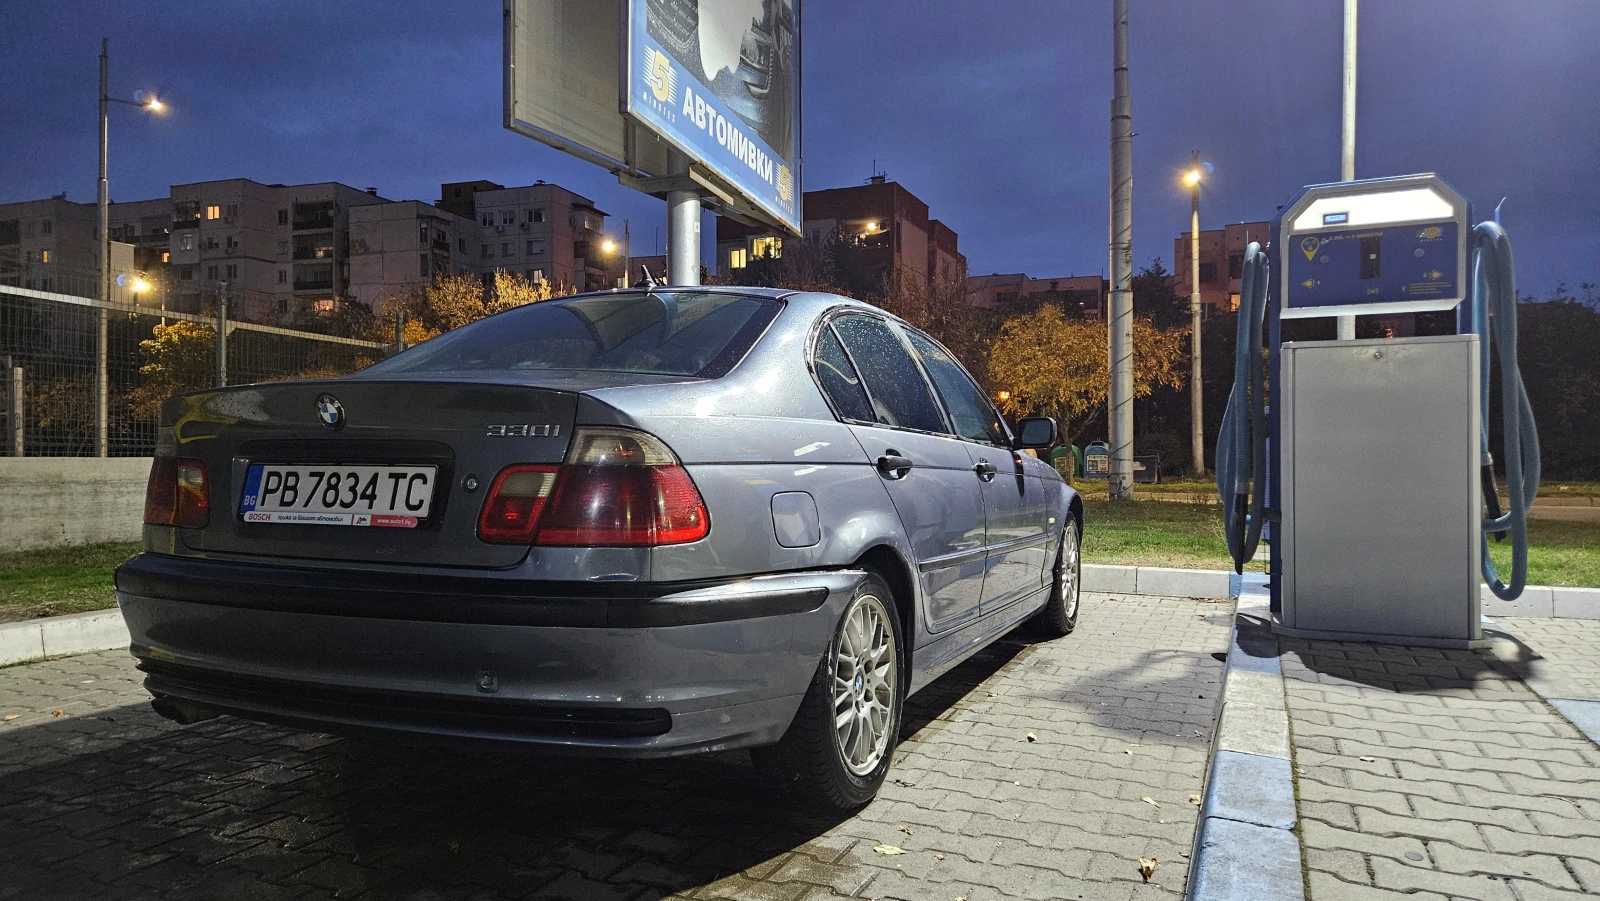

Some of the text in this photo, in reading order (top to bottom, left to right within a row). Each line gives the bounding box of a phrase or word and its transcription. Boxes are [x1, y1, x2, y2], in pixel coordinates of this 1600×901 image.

[650, 49, 670, 102] 5
[682, 86, 773, 185] АВТОМИВКИ
[779, 163, 790, 201] 5
[243, 495, 256, 506] BG
[260, 470, 428, 511] PB 7834 TC
[248, 513, 271, 521] BOSCH
